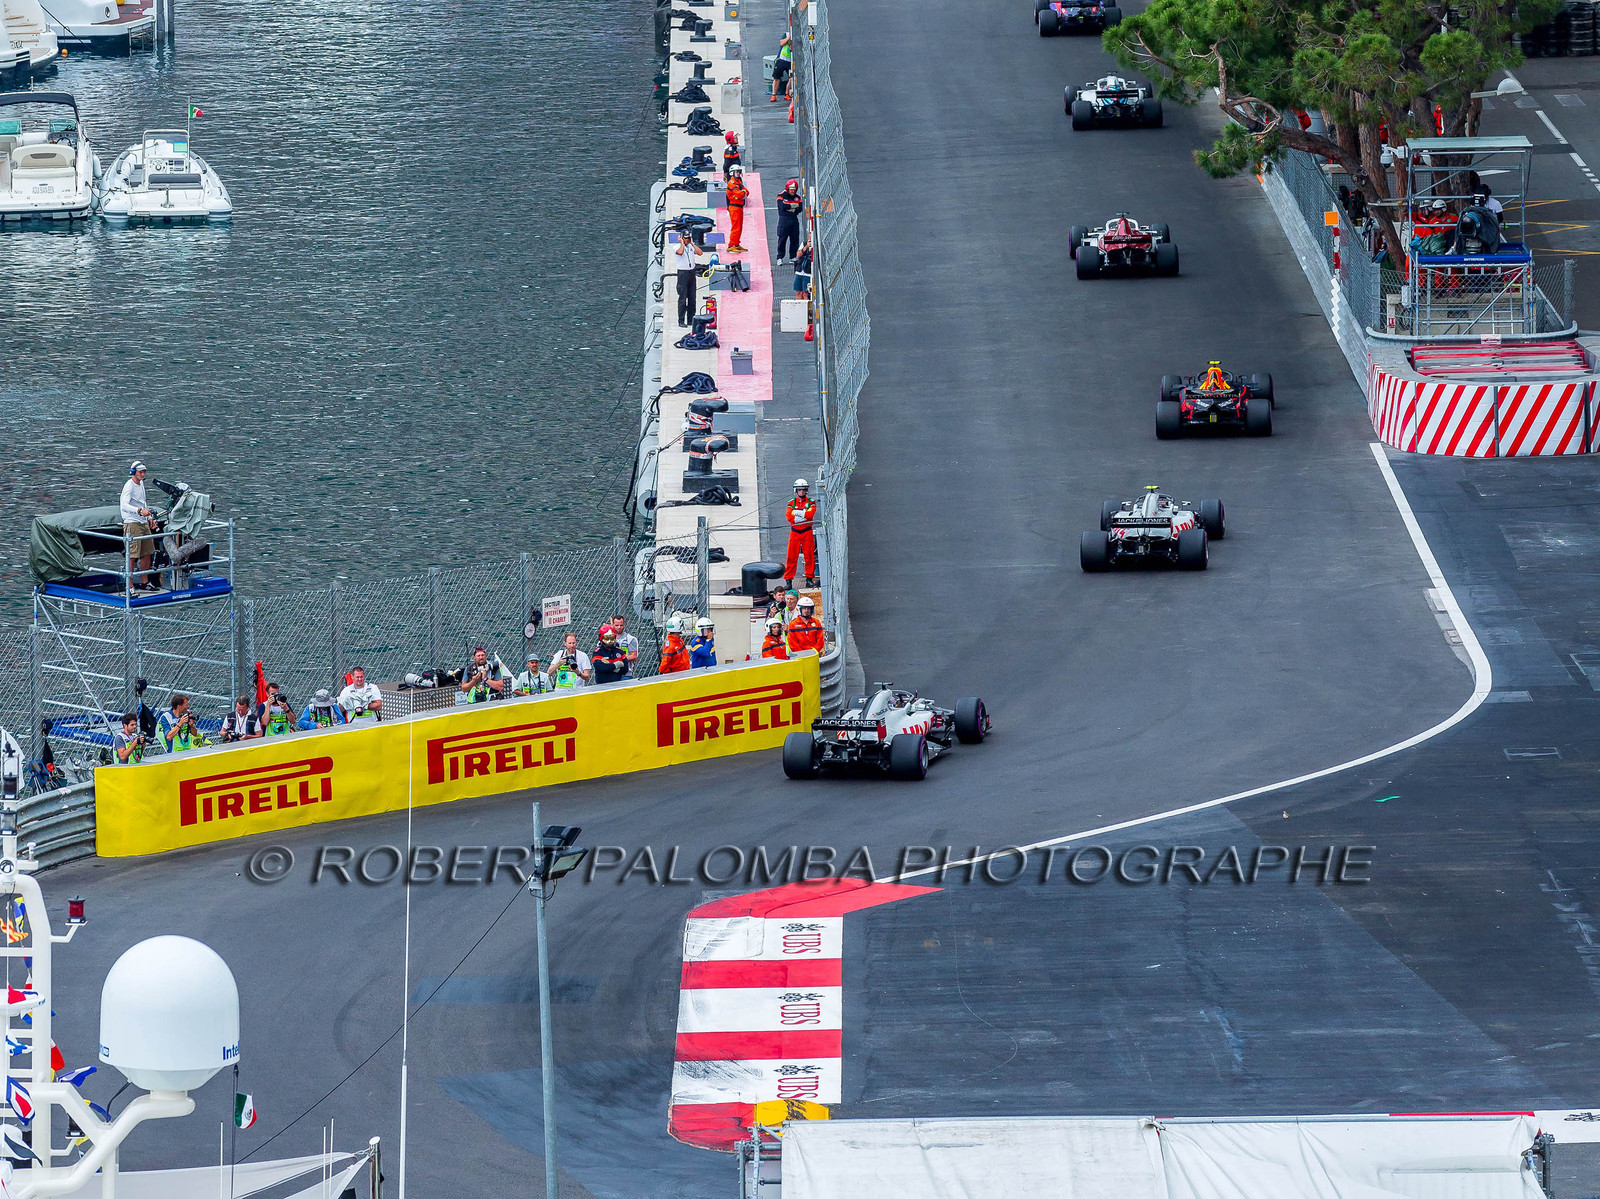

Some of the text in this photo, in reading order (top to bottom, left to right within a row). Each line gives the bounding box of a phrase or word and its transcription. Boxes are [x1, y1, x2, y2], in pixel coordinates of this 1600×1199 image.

[656, 681, 803, 747] PIRELLI
[427, 717, 577, 784] PIRELLI
[179, 756, 333, 827] PIRELLI
[782, 933, 821, 954] UBS
[780, 1003, 821, 1025] UBS
[776, 1075, 819, 1099] UBS
